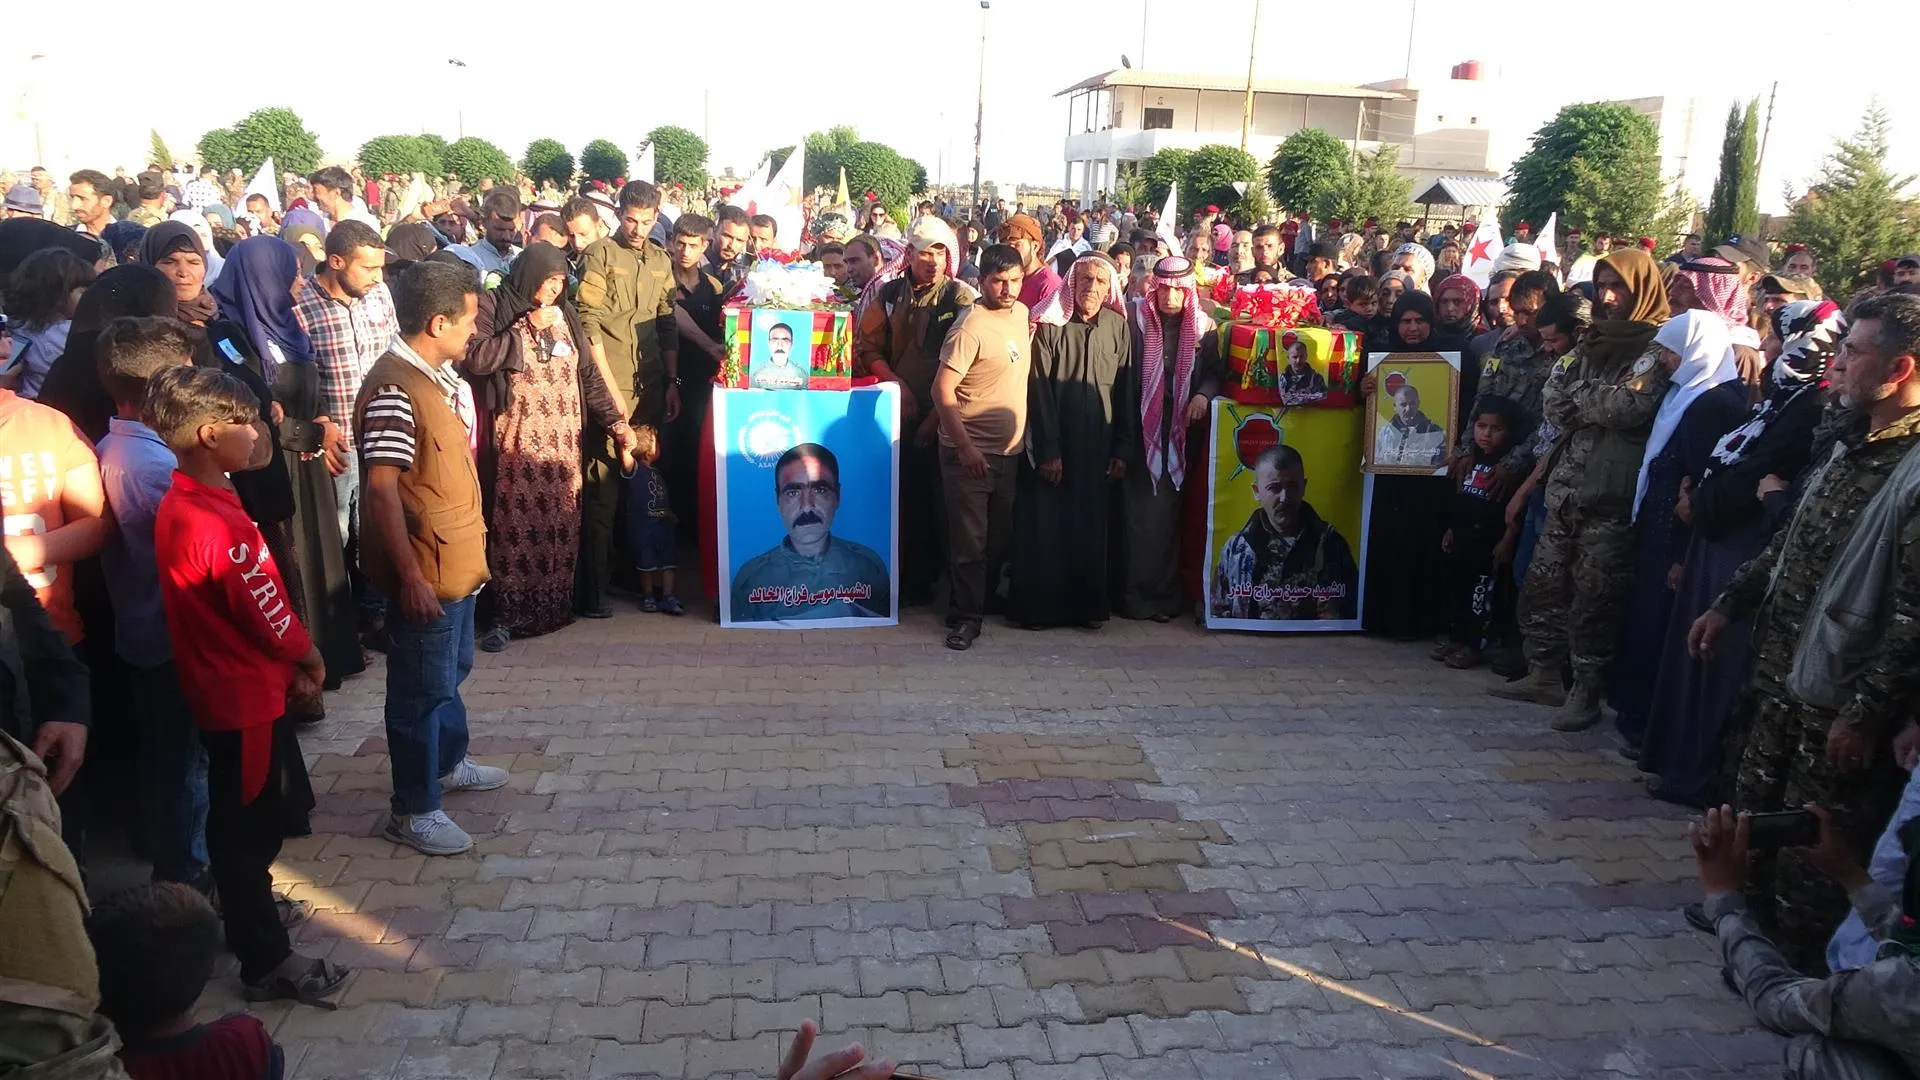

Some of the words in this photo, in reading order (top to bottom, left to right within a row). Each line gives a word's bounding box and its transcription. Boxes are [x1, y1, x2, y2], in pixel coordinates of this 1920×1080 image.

[228, 542, 291, 640] SYRIA
[749, 585, 785, 603] الخالد
[808, 587, 835, 605] موسى
[835, 582, 872, 603] الشهيد
[1253, 583, 1283, 602] سراج
[1282, 583, 1312, 602] حسين
[1313, 581, 1345, 602] الشهيد
